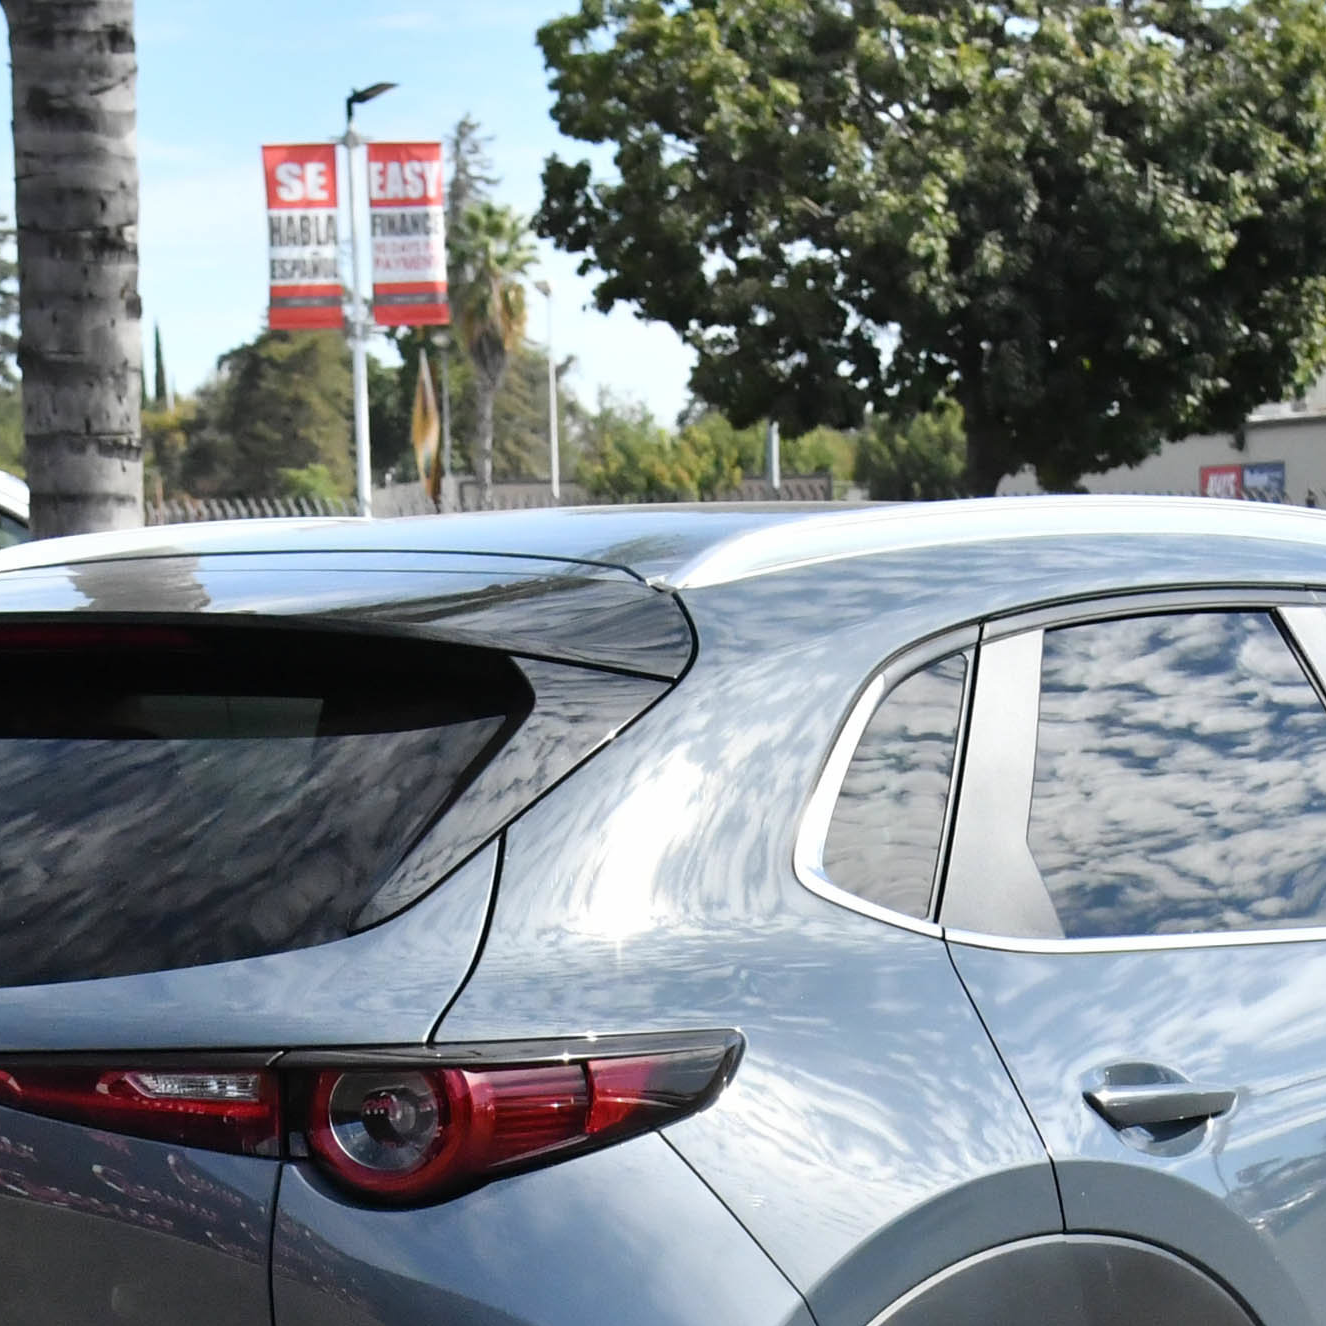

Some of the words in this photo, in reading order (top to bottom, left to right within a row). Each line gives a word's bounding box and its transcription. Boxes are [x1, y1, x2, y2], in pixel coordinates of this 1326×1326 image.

[276, 161, 329, 202] SE
[370, 160, 441, 199] EASY
[270, 215, 338, 247] HABLA
